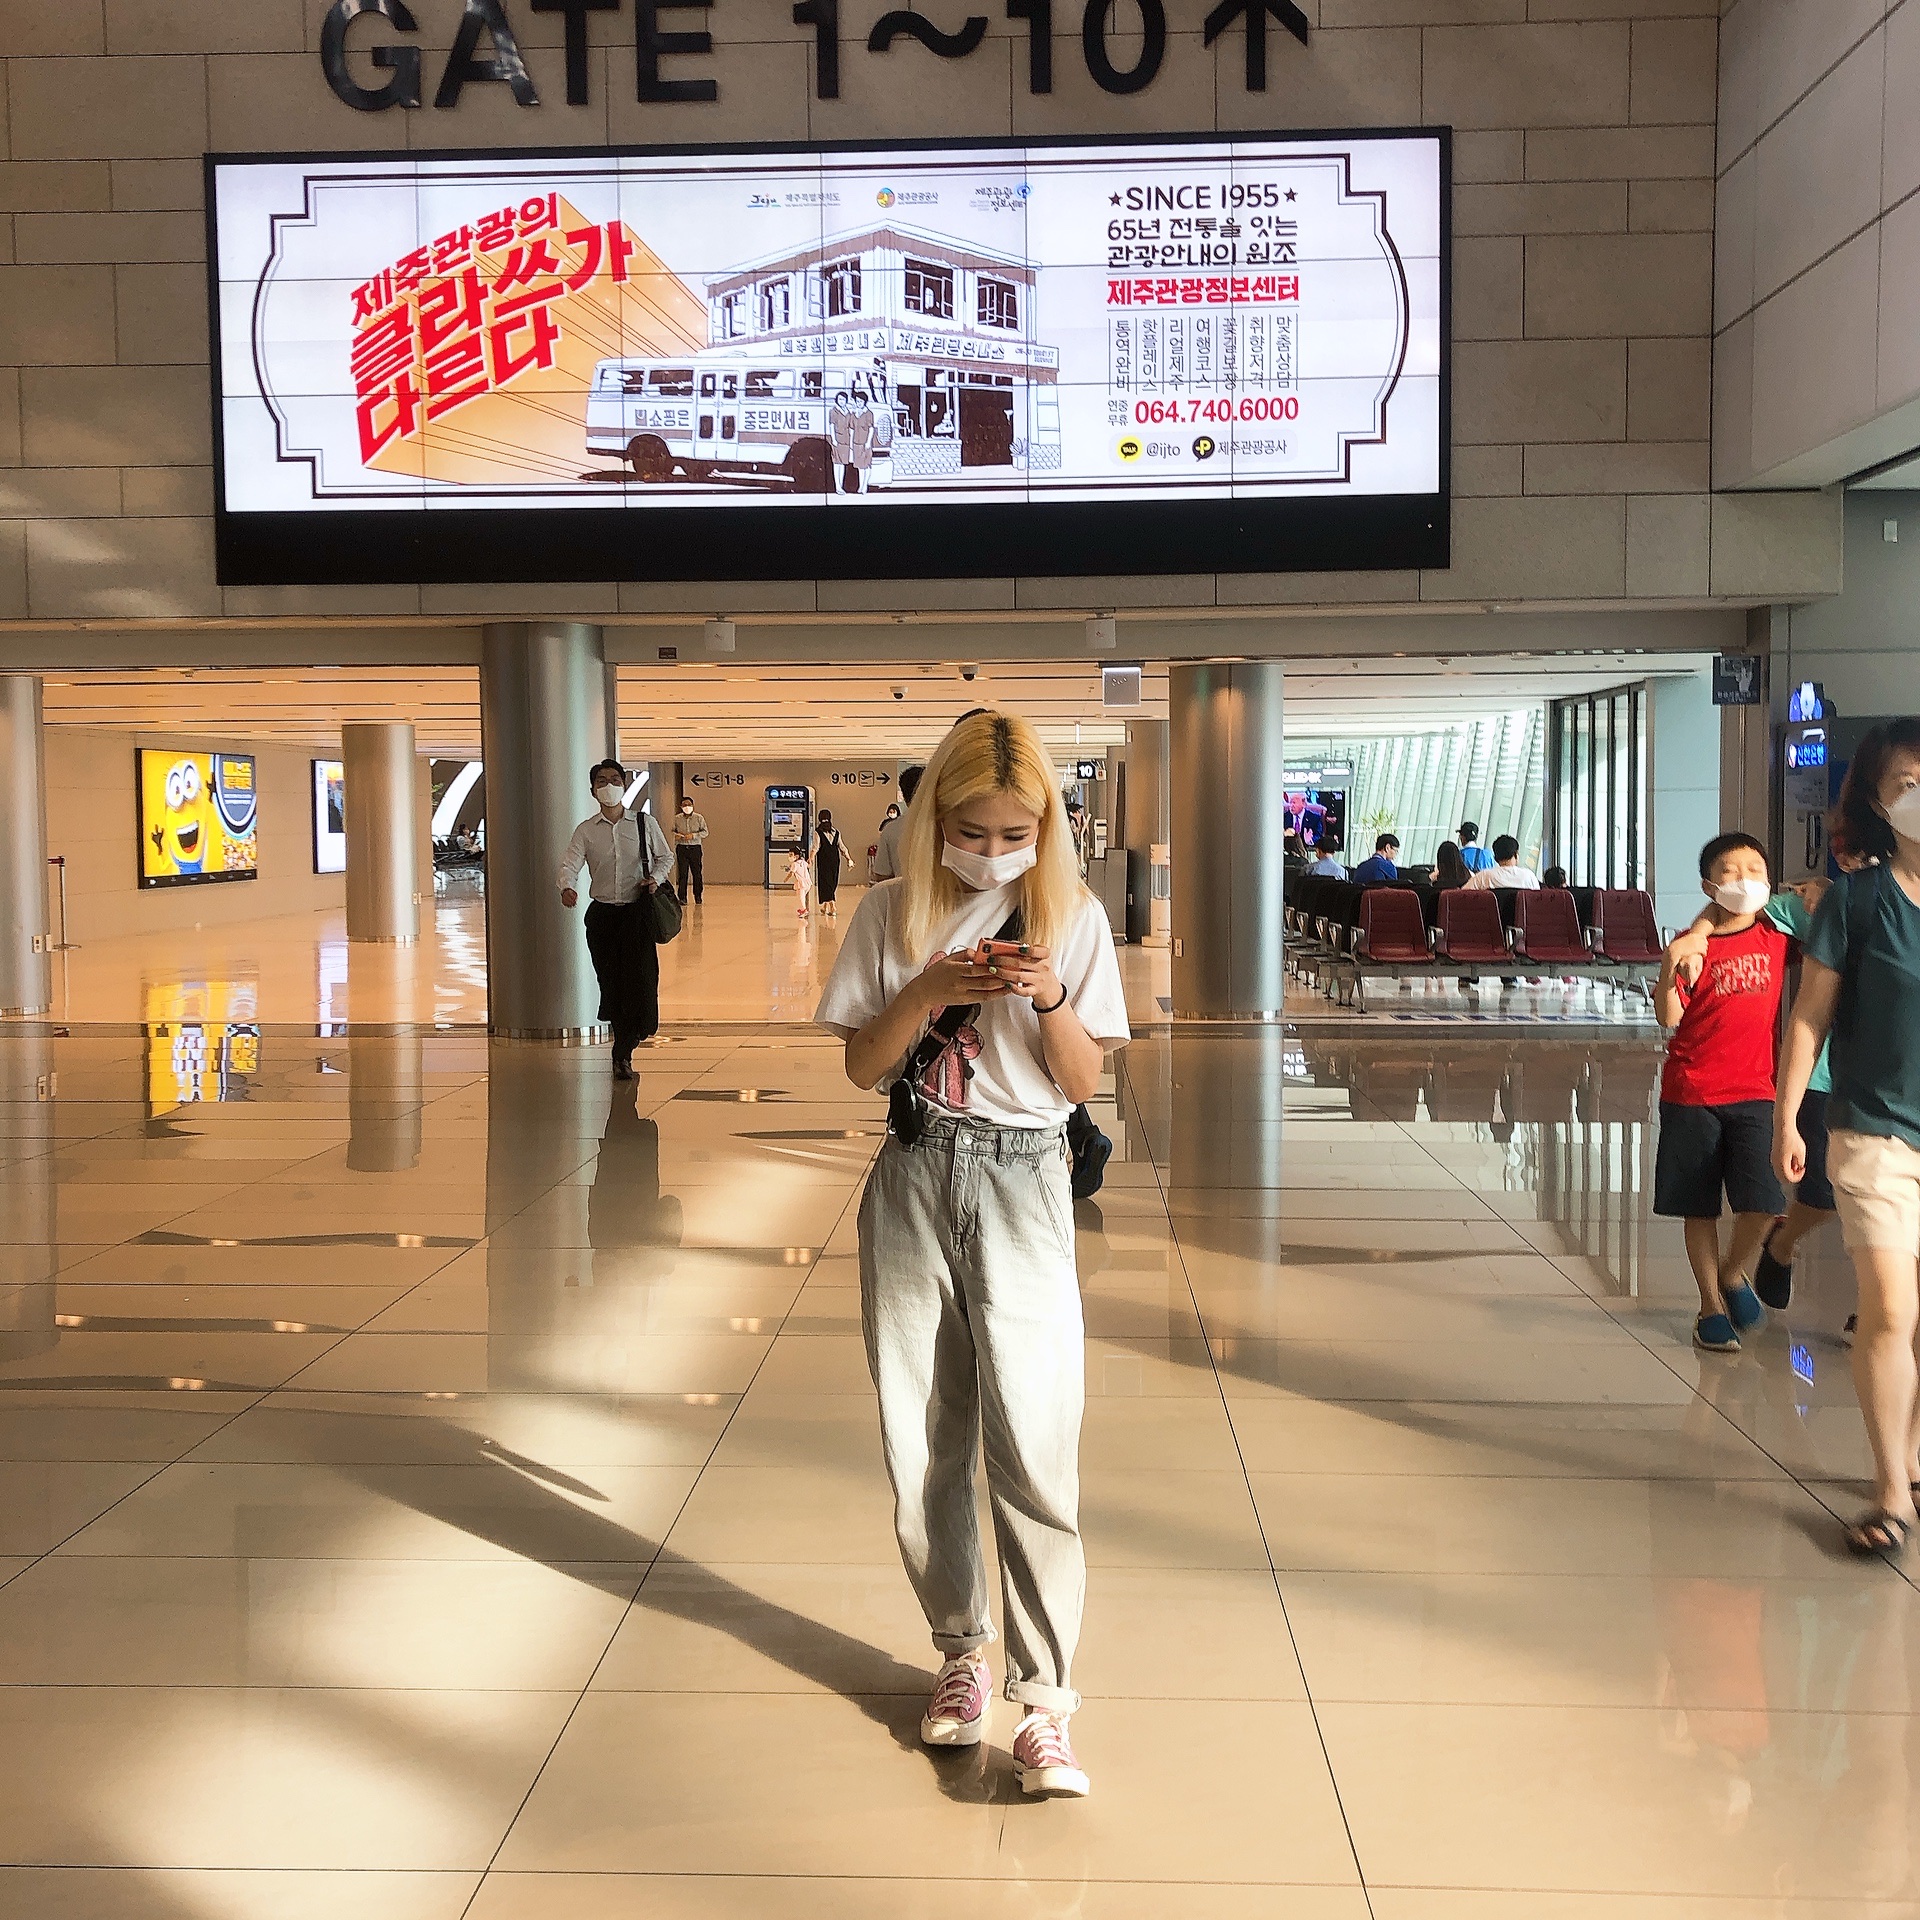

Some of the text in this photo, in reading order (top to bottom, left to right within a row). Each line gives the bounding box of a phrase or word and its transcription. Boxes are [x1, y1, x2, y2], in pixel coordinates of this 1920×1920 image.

[321, 0, 717, 112] GATE
[1107, 215, 1298, 241] 65년 전통을 잇는
[1126, 183, 1280, 211] SINCE 1955
[350, 191, 560, 327] 제주관광의
[1107, 241, 1298, 268] 관광안내의 원조
[1107, 274, 1300, 306] 제주관광정보센터
[350, 220, 634, 400] 클라쓰가
[356, 304, 560, 467] 다르다
[1115, 319, 1132, 393] 통역완비
[1141, 318, 1158, 392] 핫플레이스
[1168, 318, 1185, 392] 리얼제주
[1195, 317, 1212, 389] 여행코스
[1249, 316, 1265, 390] 취향저격
[1275, 315, 1292, 389] 맞춤상담
[744, 410, 810, 431] 중문면세점
[1134, 397, 1300, 424] 064.740.6000
[1146, 442, 1181, 459] @ijto
[1217, 439, 1288, 456] 제주관광공사
[1078, 764, 1094, 778] 10
